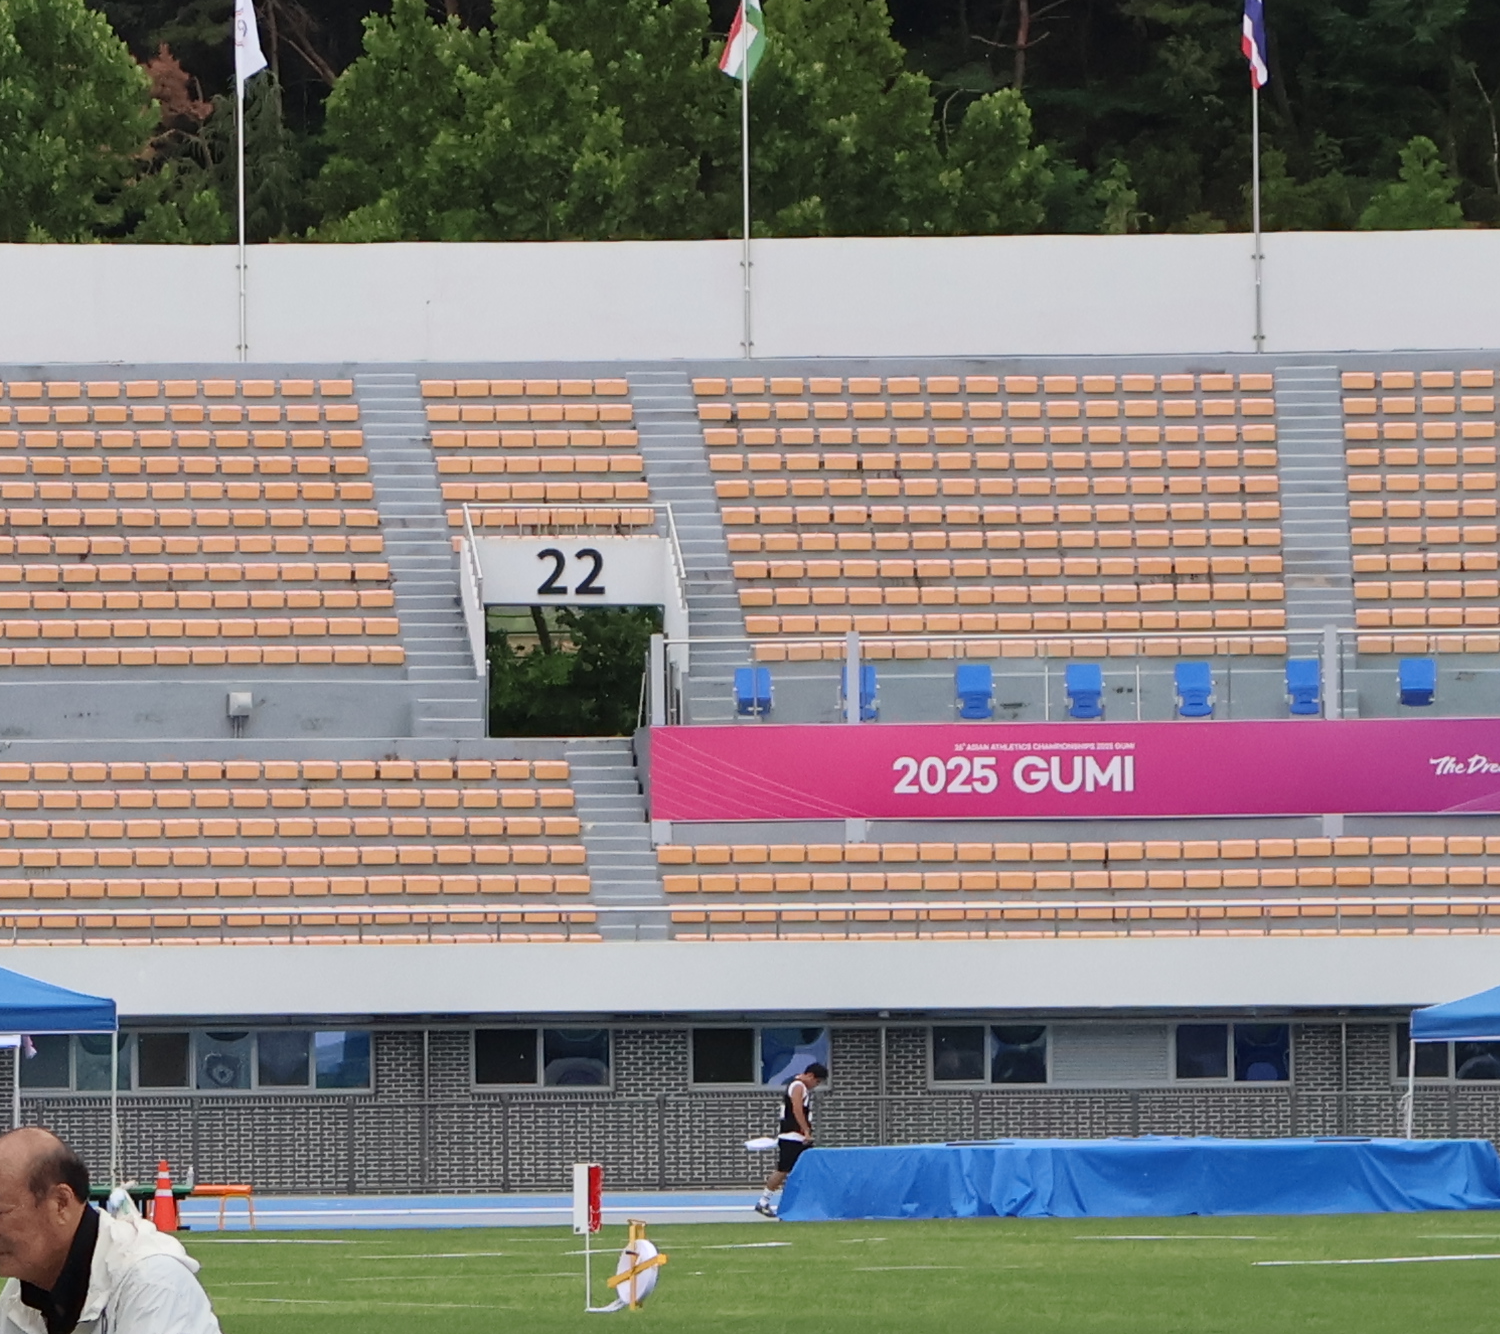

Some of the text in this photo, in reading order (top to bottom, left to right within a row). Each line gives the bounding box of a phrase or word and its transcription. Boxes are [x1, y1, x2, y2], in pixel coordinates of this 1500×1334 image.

[537, 548, 606, 594] 22
[892, 755, 1135, 794] 2025 GUMI
[1429, 756, 1466, 776] The
